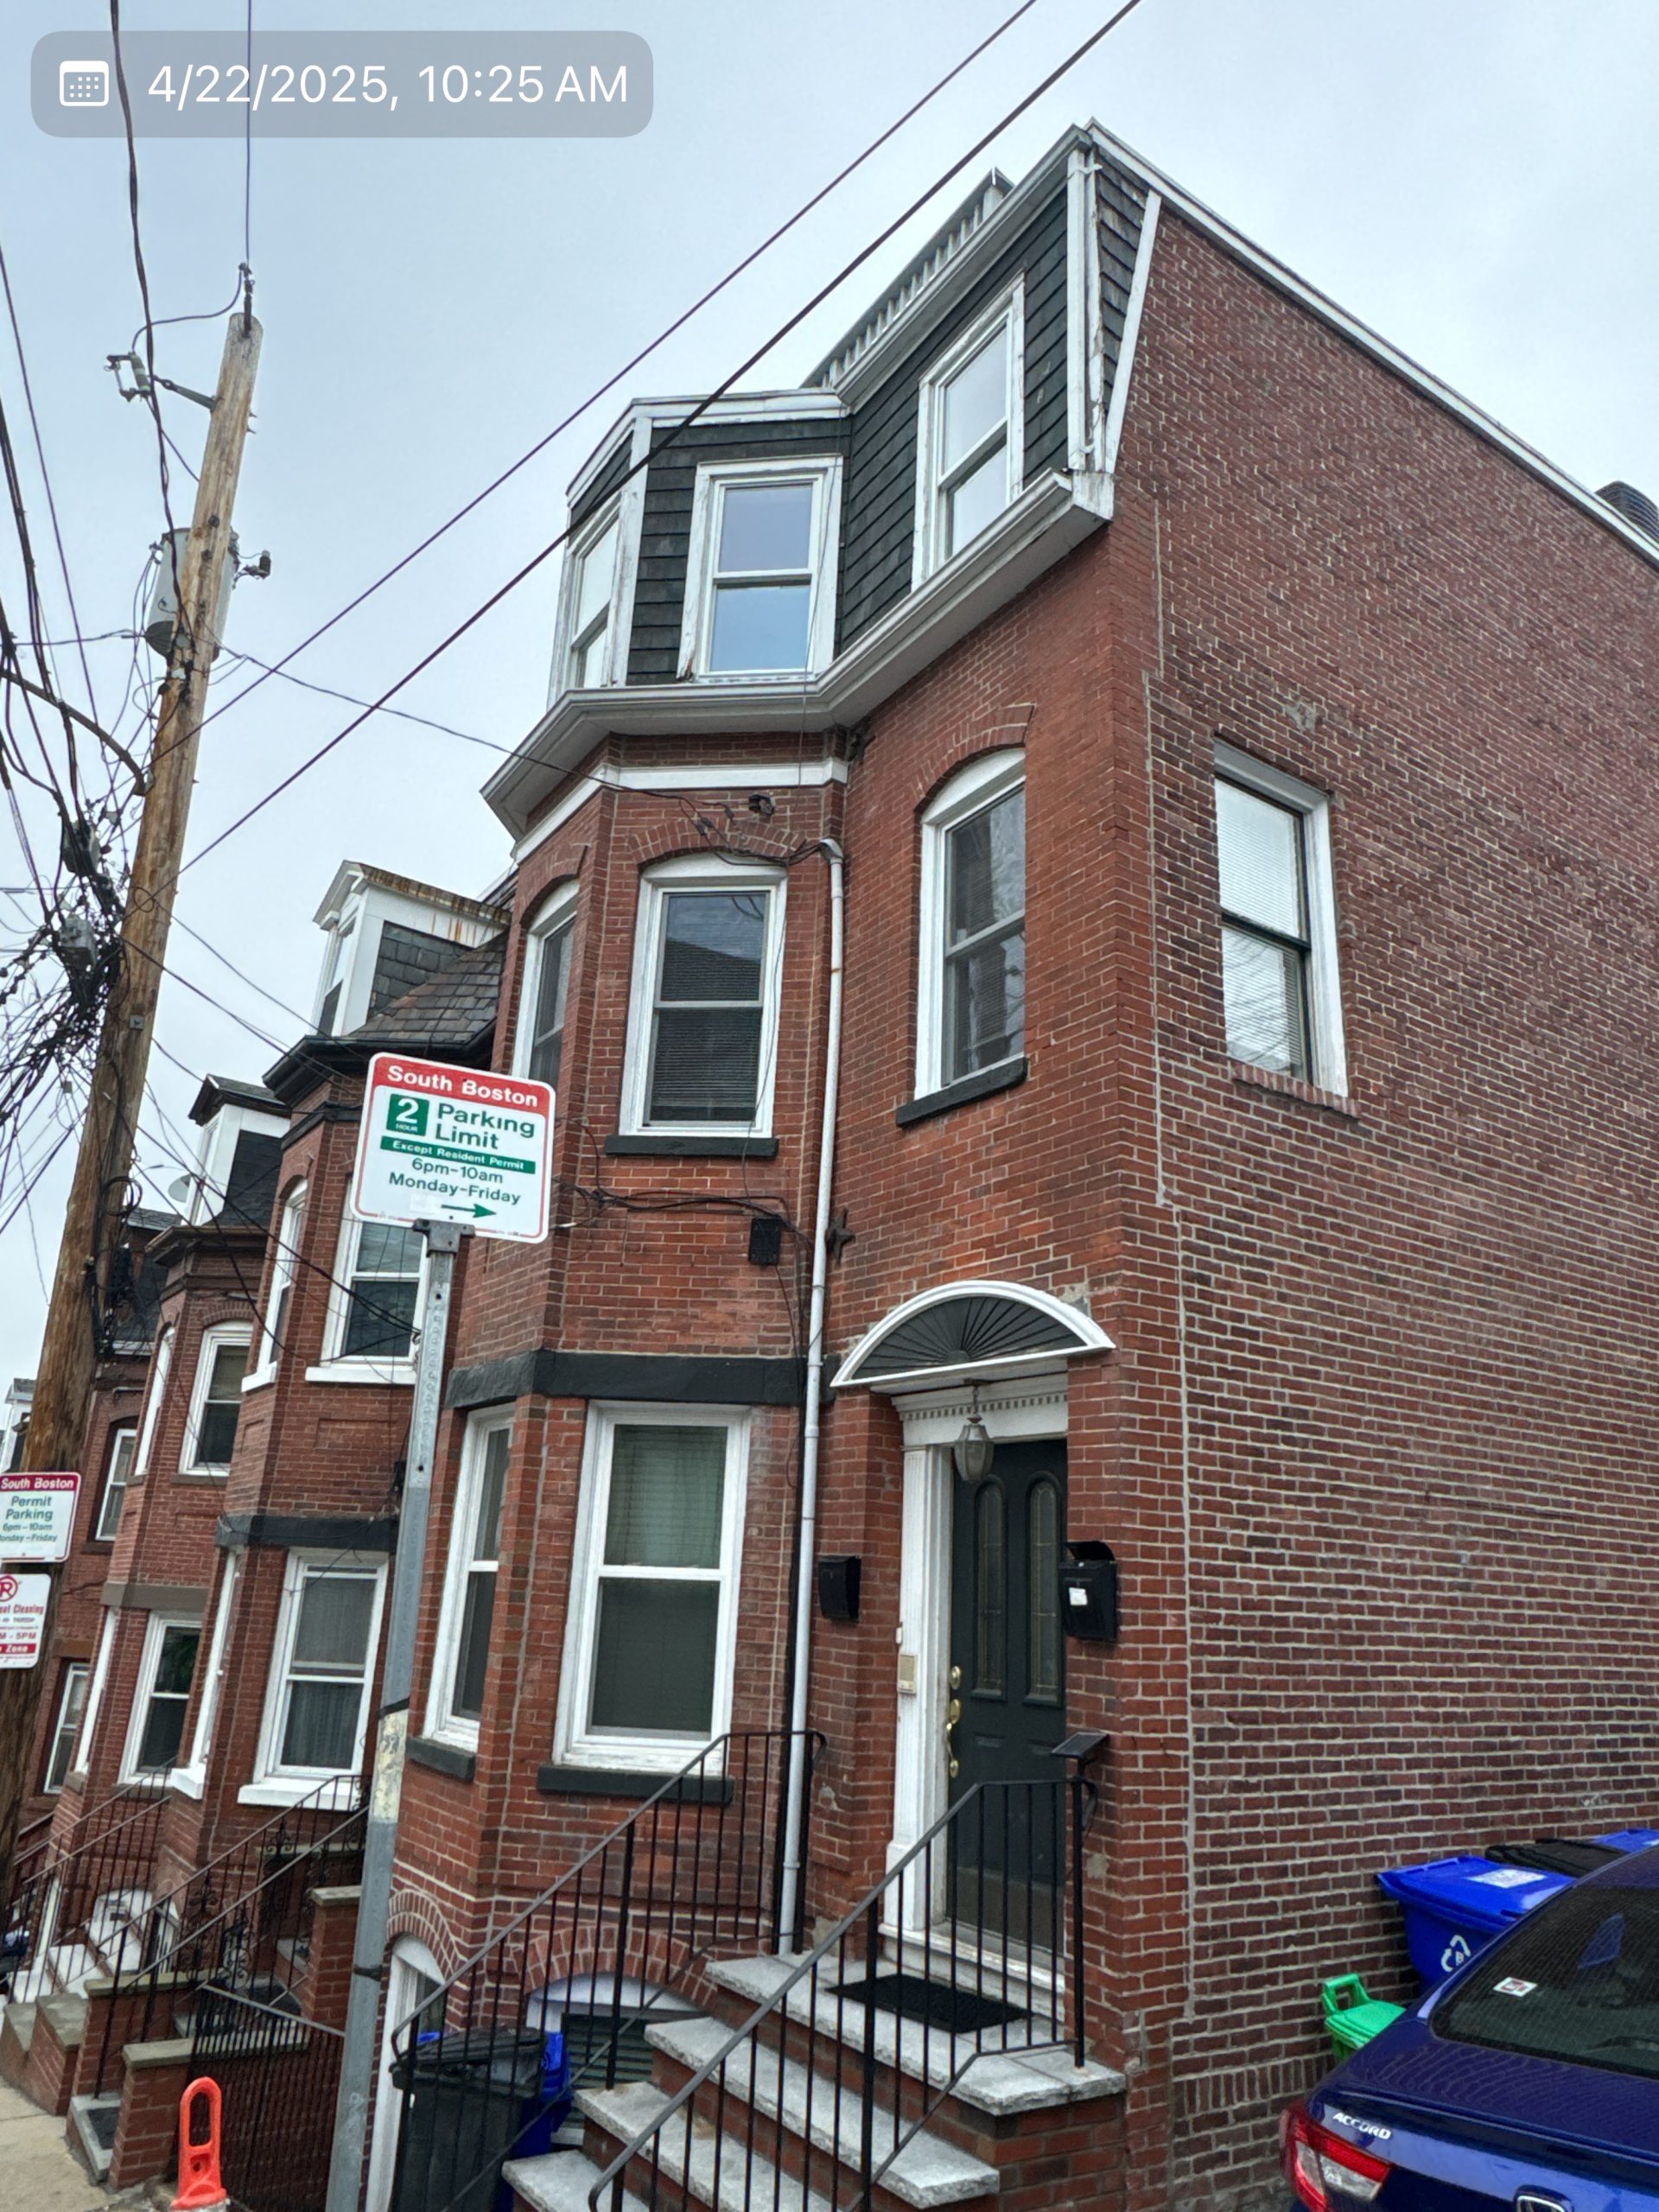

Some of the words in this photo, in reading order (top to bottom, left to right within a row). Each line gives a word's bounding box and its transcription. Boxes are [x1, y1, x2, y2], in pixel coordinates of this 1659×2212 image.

[387, 1065, 453, 1092] South
[461, 1079, 537, 1108] Boston
[395, 1097, 419, 1124] 2
[437, 1103, 535, 1139] Parking
[395, 1123, 418, 1133] HOUR
[435, 1123, 499, 1150] Limit
[392, 1140, 433, 1155] Except
[436, 1147, 485, 1164] Resident
[489, 1156, 524, 1171] Permit
[411, 1158, 504, 1184] 6pm-10am
[389, 1172, 521, 1205] Monday-Friday
[1, 1477, 30, 1490] South
[34, 1477, 74, 1490] Boston
[5, 1509, 54, 1521] Parking
[10, 1496, 52, 1507] Permit
[1332, 2112, 1392, 2139] ACCORD
